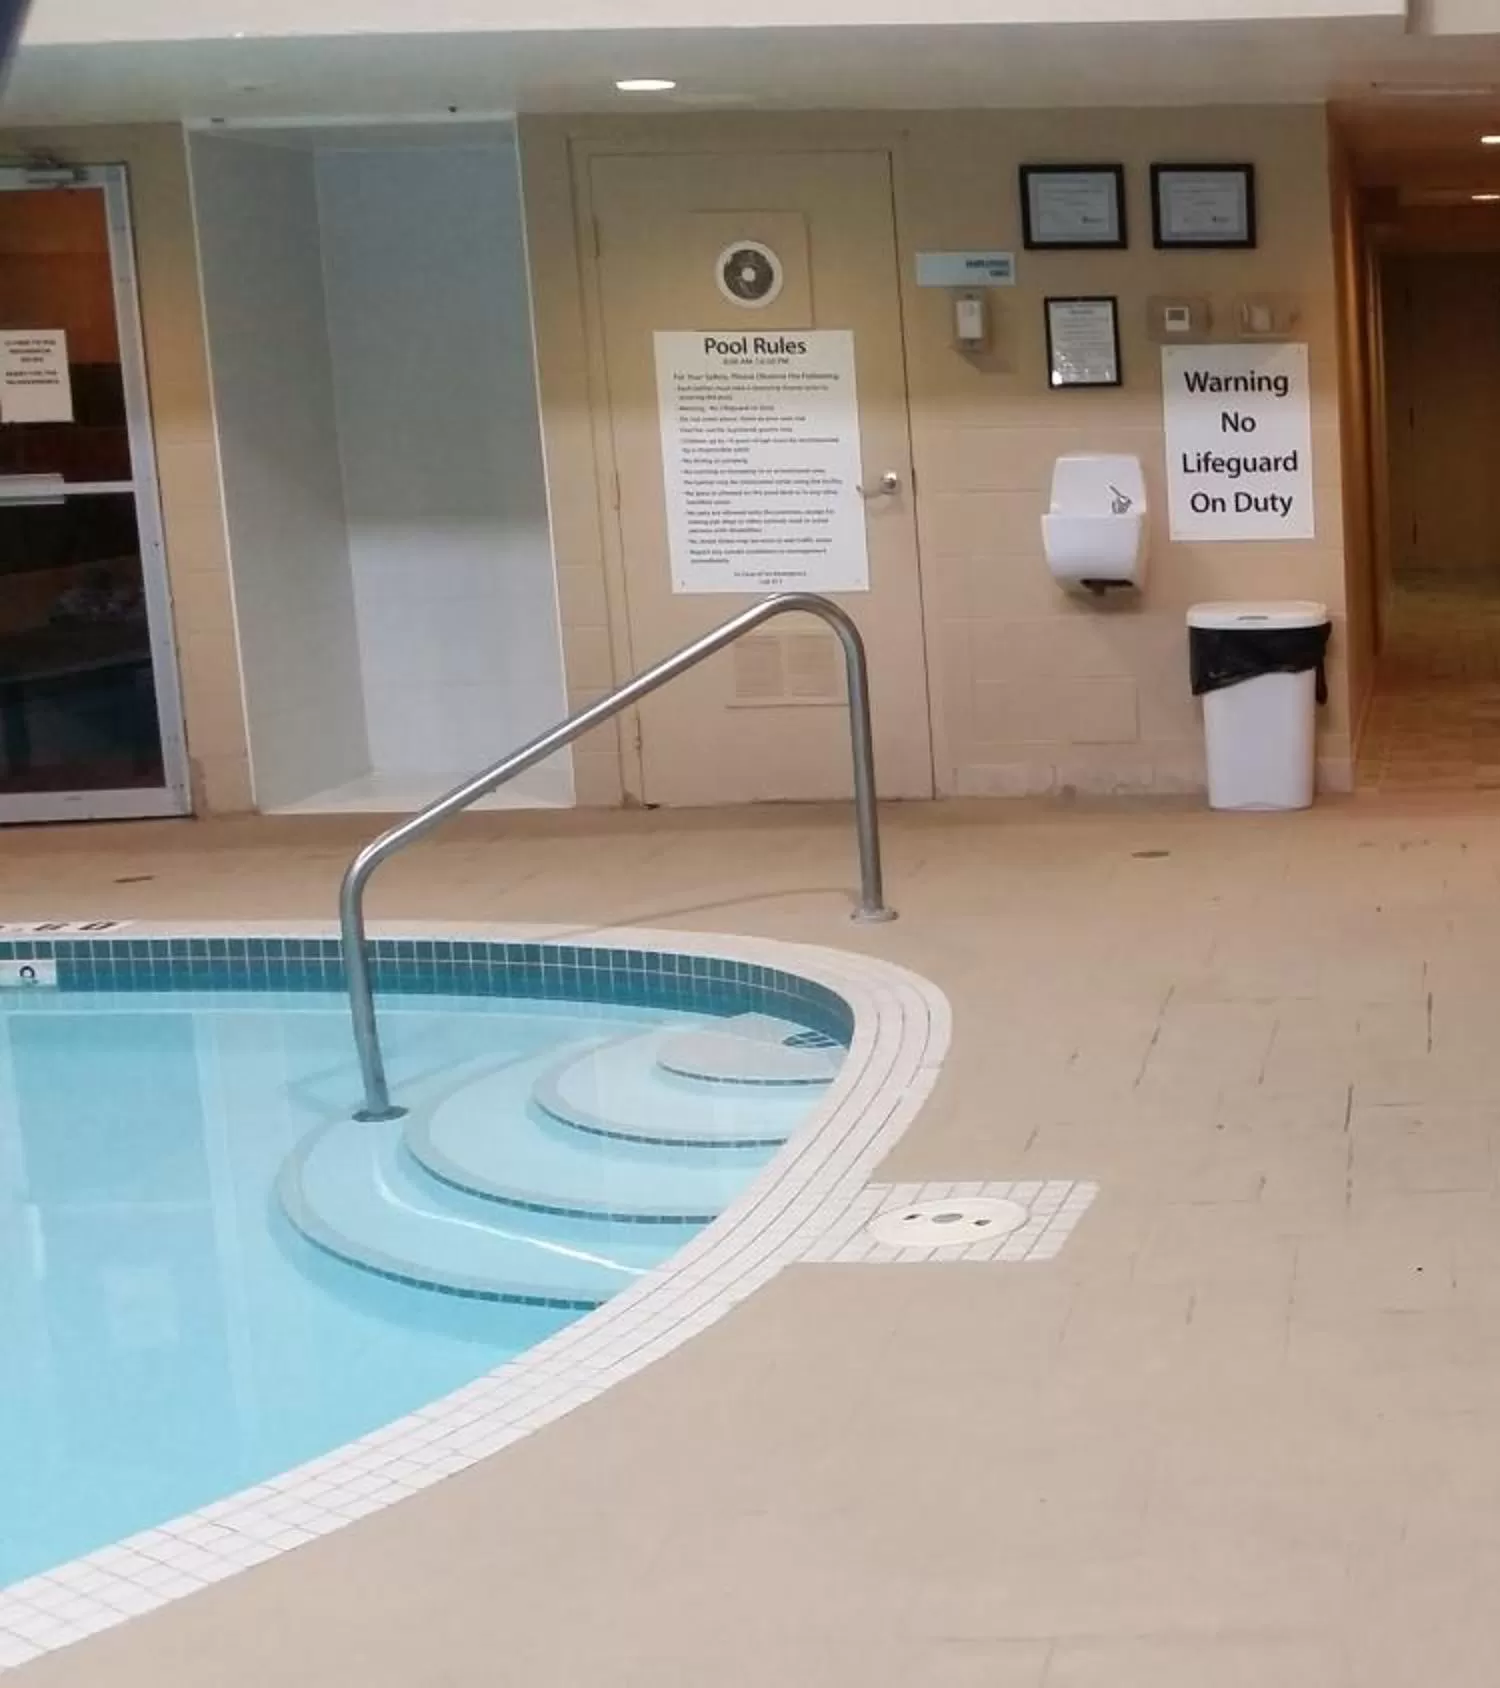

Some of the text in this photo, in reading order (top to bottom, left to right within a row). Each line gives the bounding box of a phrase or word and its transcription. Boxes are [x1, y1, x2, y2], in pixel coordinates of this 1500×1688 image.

[704, 336, 807, 354] Pool Rules
[1184, 370, 1289, 397] Warning
[1221, 411, 1257, 433] No
[1182, 450, 1298, 479] Lifeguard
[1190, 491, 1293, 517] On Duty
